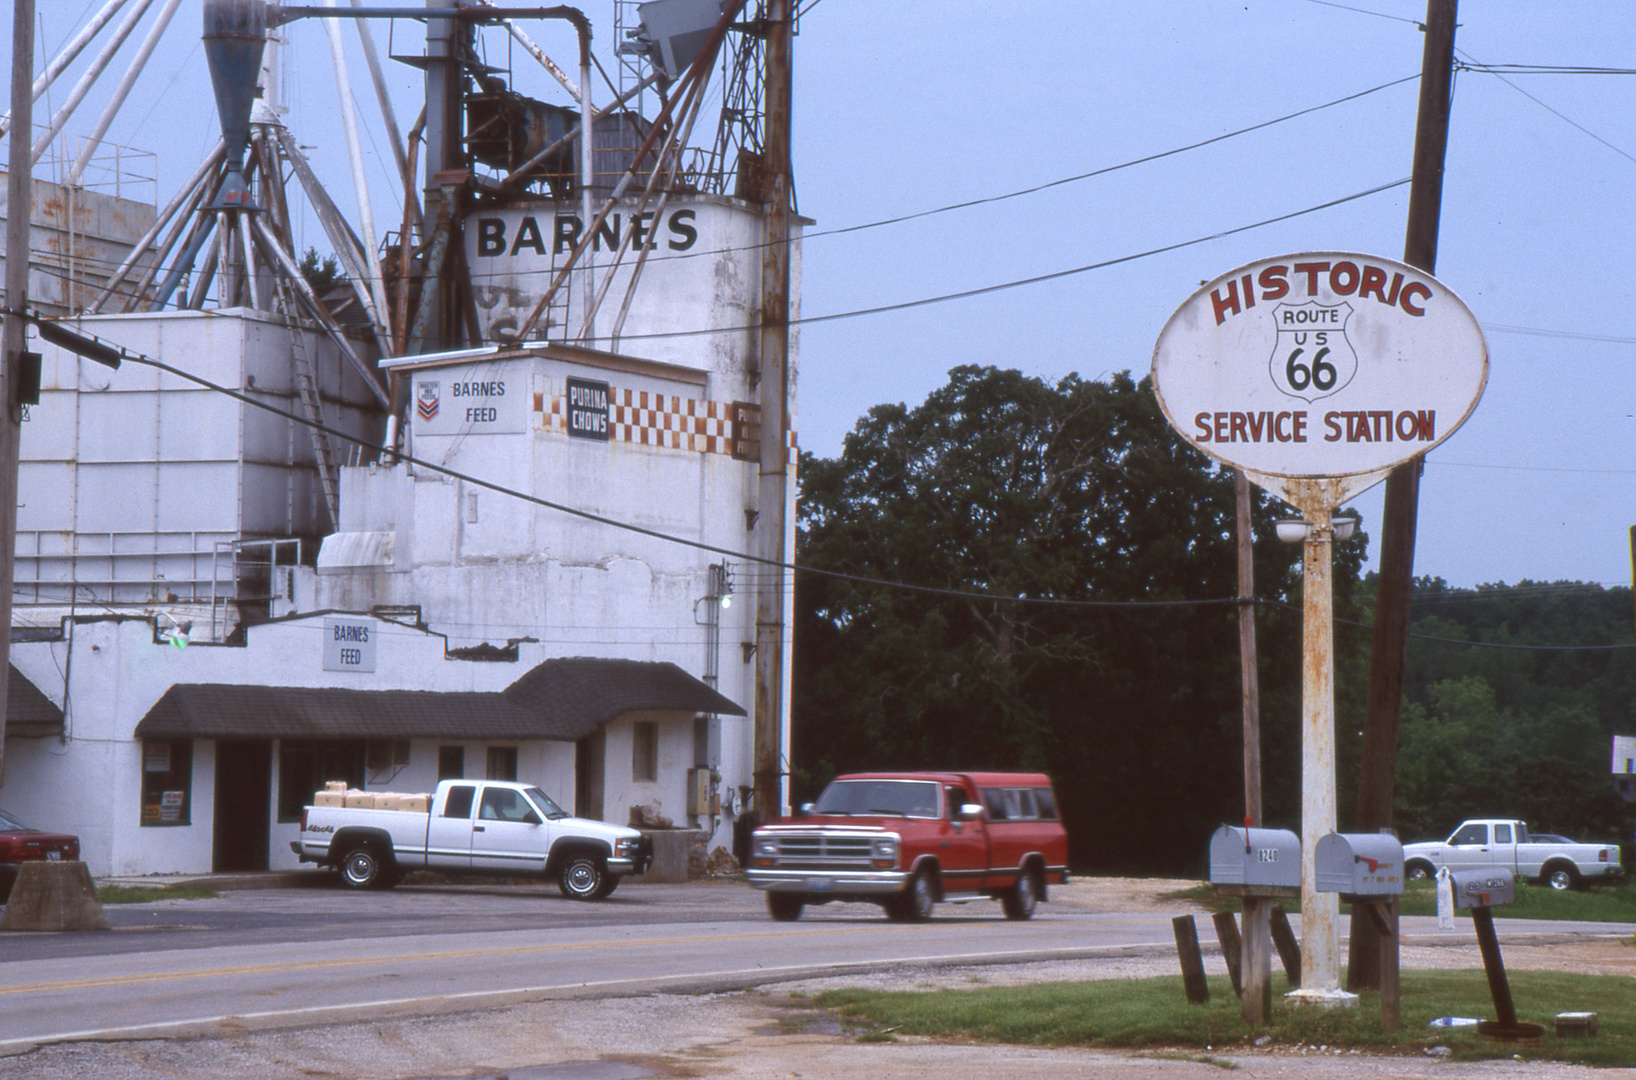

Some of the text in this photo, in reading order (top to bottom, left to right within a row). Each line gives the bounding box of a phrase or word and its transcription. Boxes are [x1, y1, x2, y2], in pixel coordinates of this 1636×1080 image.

[477, 209, 698, 257] BARNES
[1210, 261, 1433, 326] HISTORIC
[1283, 309, 1338, 324] ROUTE
[1286, 347, 1337, 391] 66
[453, 381, 505, 397] BARNES
[571, 386, 608, 410] PURINA
[466, 407, 497, 422] FEED
[572, 410, 607, 433] CHOWS
[1195, 410, 1436, 443] SERVICE STATION
[334, 625, 369, 643] BARNES
[341, 648, 361, 664] FEED
